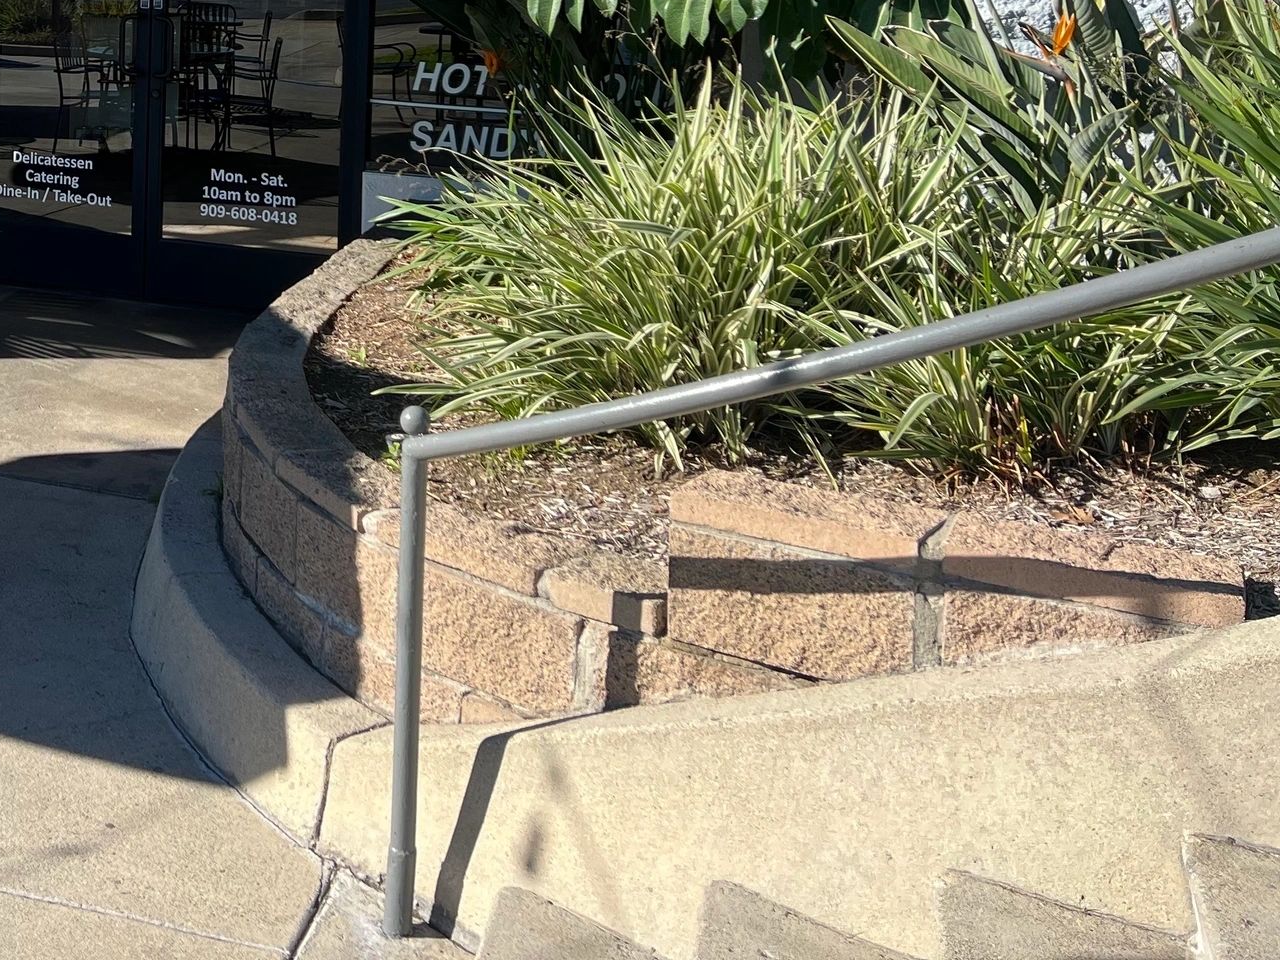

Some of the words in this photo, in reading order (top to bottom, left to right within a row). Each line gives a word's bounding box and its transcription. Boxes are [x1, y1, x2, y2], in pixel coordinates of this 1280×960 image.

[412, 61, 489, 96] HOT
[12, 150, 94, 170] Delicatessen
[25, 169, 80, 189] Catering
[210, 168, 248, 184] Mon.
[260, 172, 288, 187] Sat.
[42, 187, 50, 203] /
[52, 189, 112, 207] Take-Out
[202, 185, 241, 201] 10am
[244, 190, 260, 203] to
[263, 191, 296, 208] 8pm
[200, 203, 298, 225] 909-608-0418
